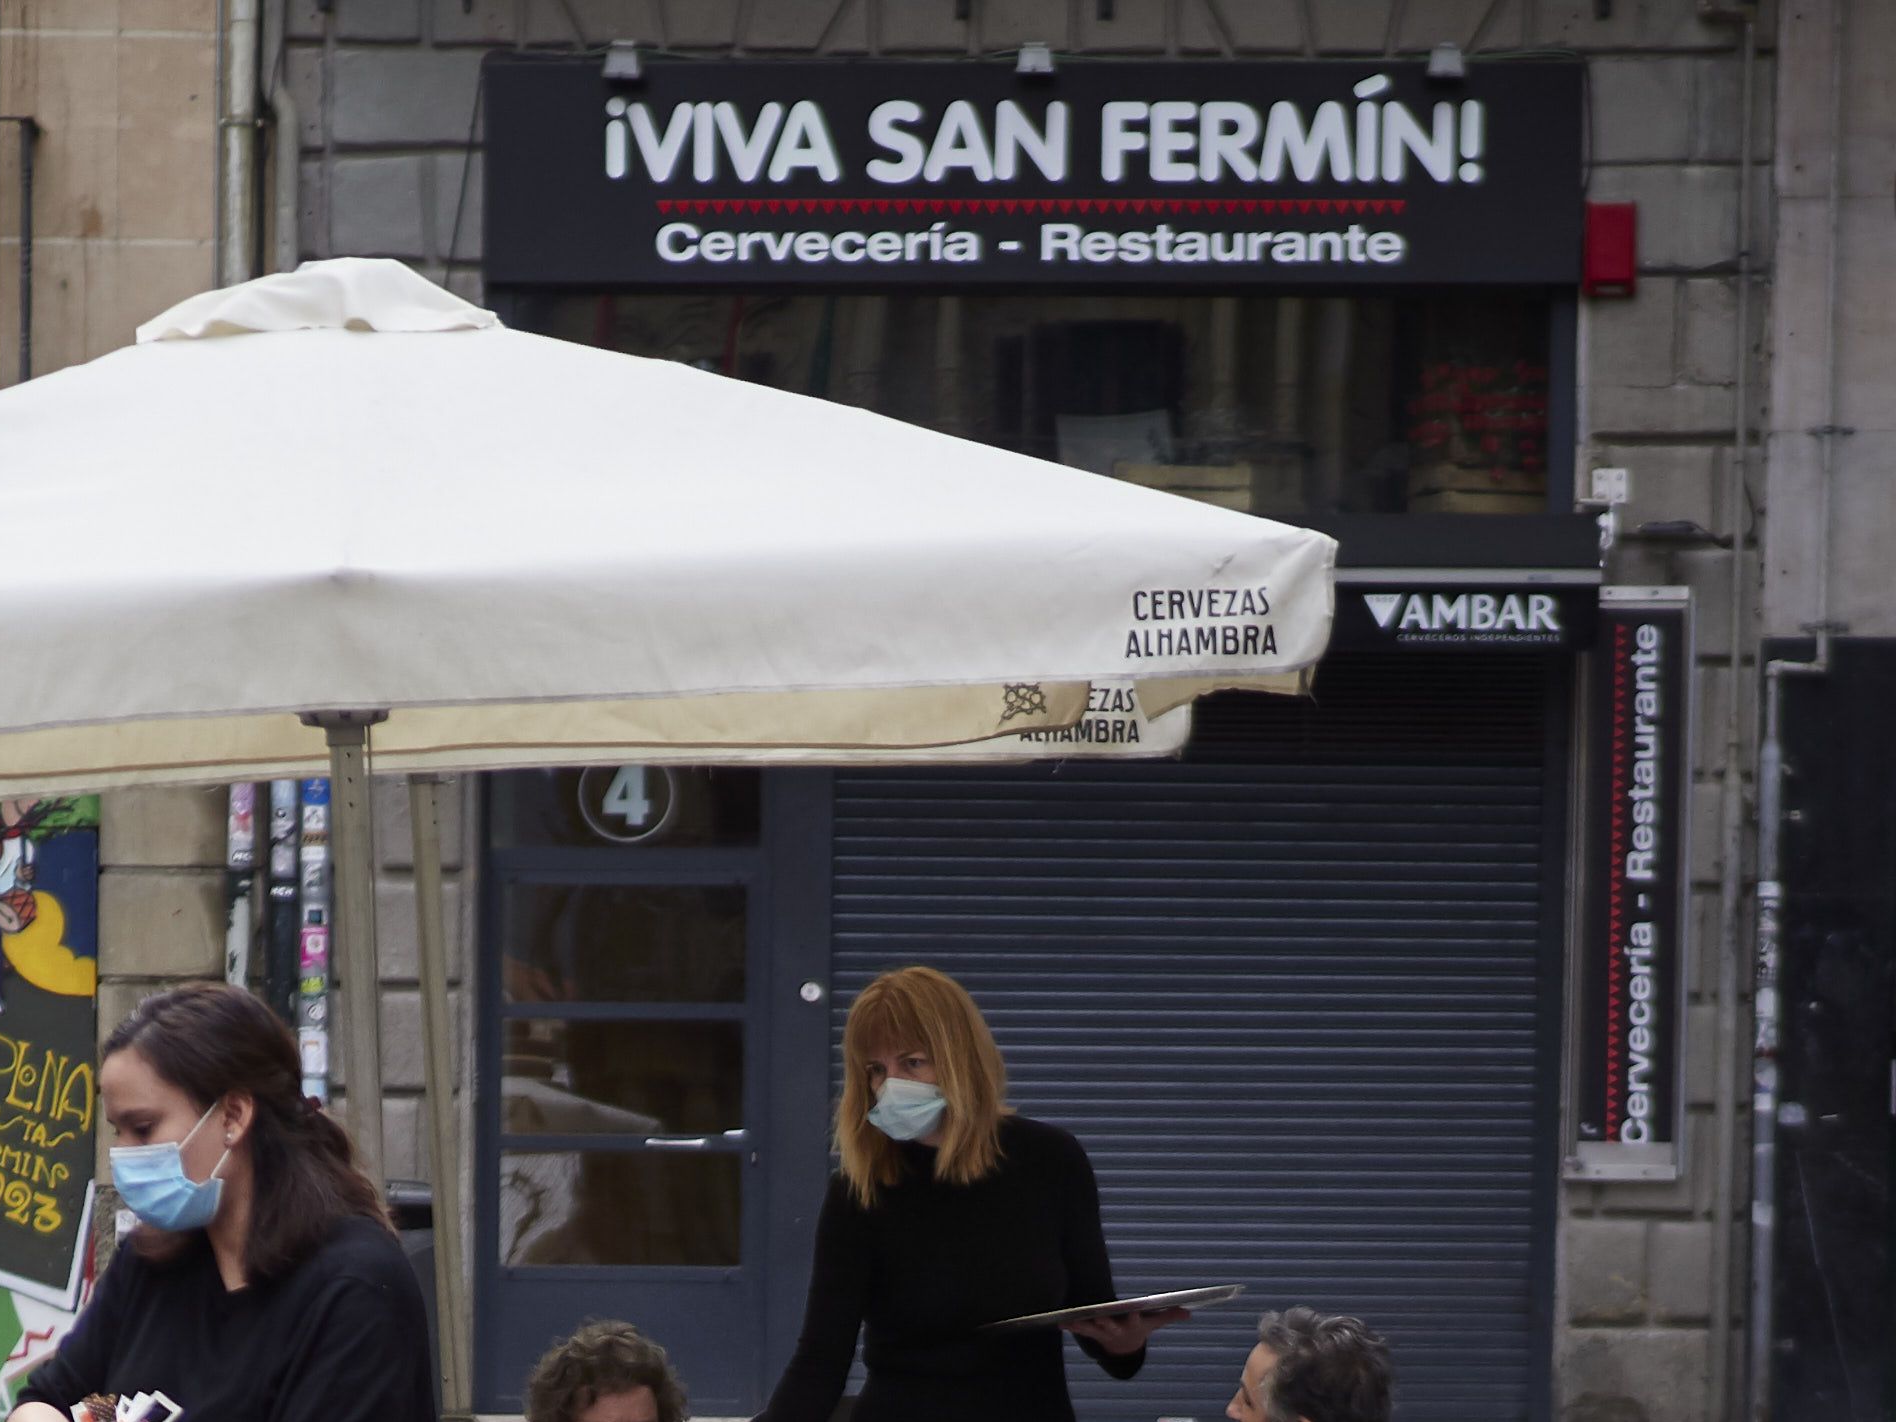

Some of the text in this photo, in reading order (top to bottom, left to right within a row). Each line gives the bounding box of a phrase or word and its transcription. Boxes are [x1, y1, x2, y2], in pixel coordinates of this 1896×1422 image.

[606, 73, 1482, 184] ¡VIVA SAN FERMÍN!
[656, 221, 980, 262] Cervecería
[1040, 223, 1403, 263] Restaurante
[1132, 586, 1270, 622] CERVEZAS
[1398, 593, 1562, 631] AMBAR
[1124, 624, 1278, 659] ALHAMBRA
[1625, 623, 1658, 880] Restaurante
[601, 763, 651, 826] 4
[1620, 920, 1654, 1146] Cervecería
